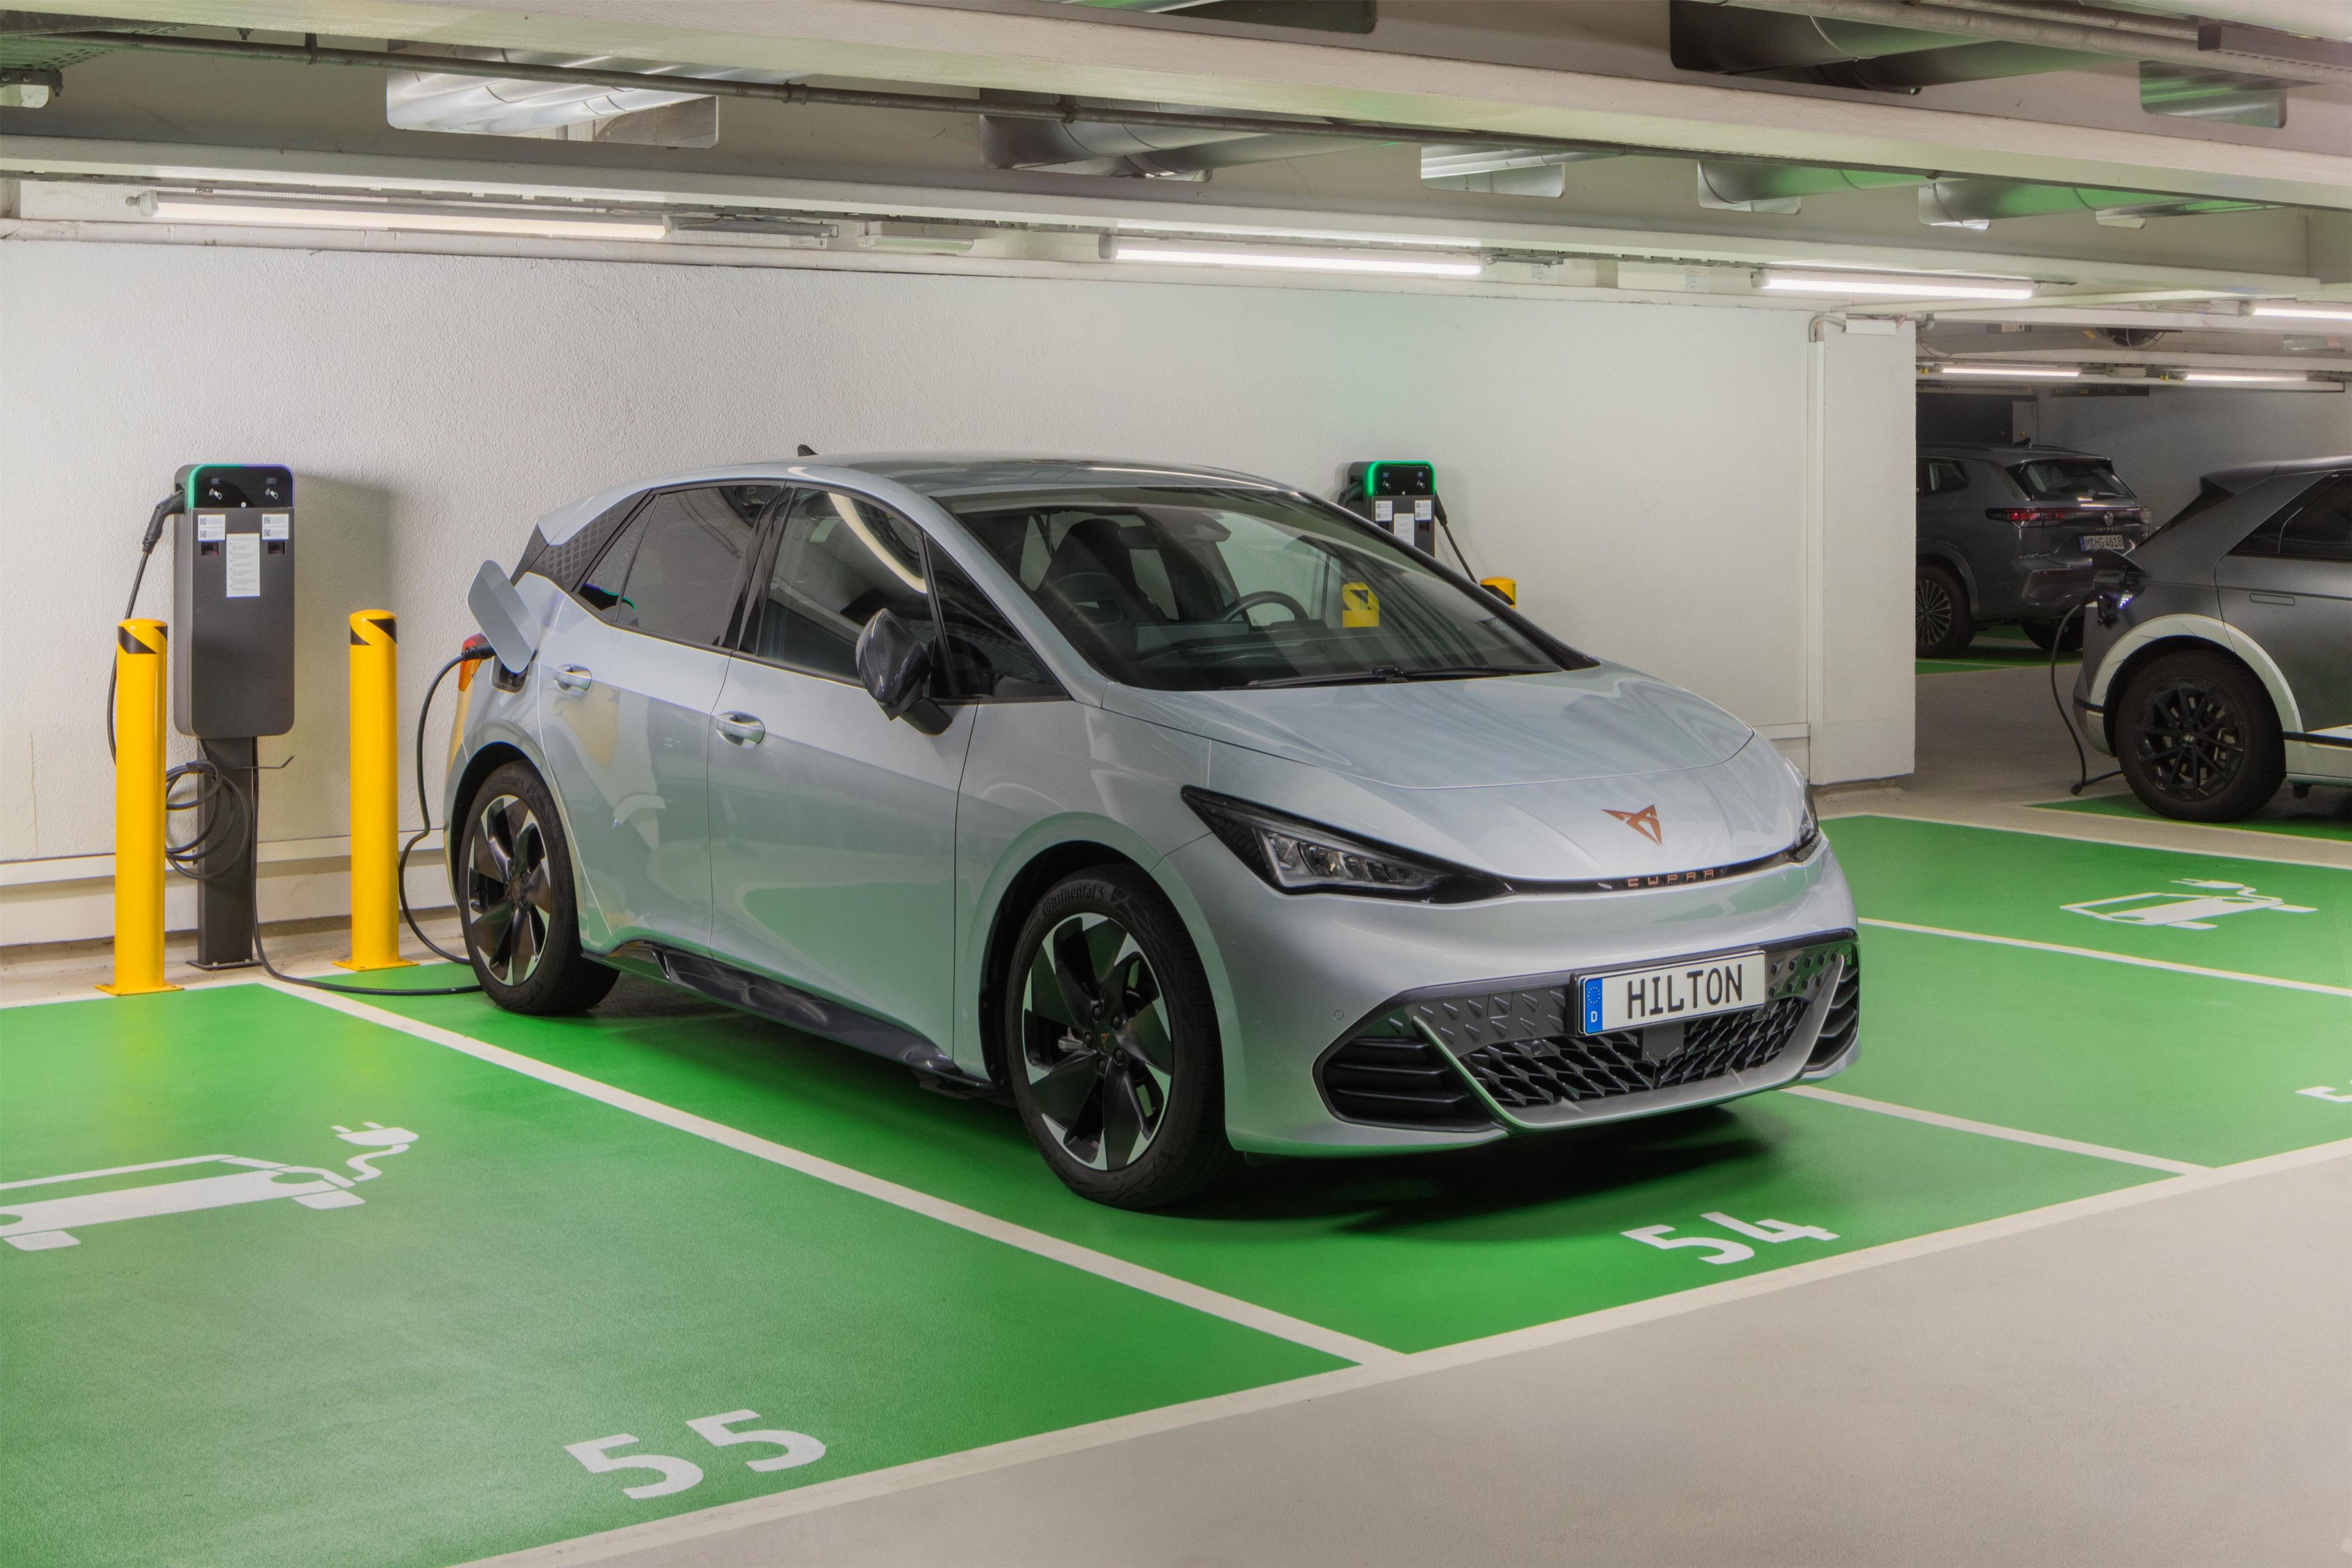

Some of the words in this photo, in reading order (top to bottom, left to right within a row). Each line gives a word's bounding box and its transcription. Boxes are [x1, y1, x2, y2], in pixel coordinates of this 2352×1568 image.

[2094, 537, 2105, 548] HG
[2106, 537, 2122, 547] 4618
[1042, 884, 1097, 916] Continental
[1627, 869, 1714, 888] CUPRA
[1591, 1011, 1597, 1023] D
[1627, 963, 1743, 1020] HILTON
[1619, 1211, 1841, 1265] 54
[564, 1408, 827, 1500] 55
